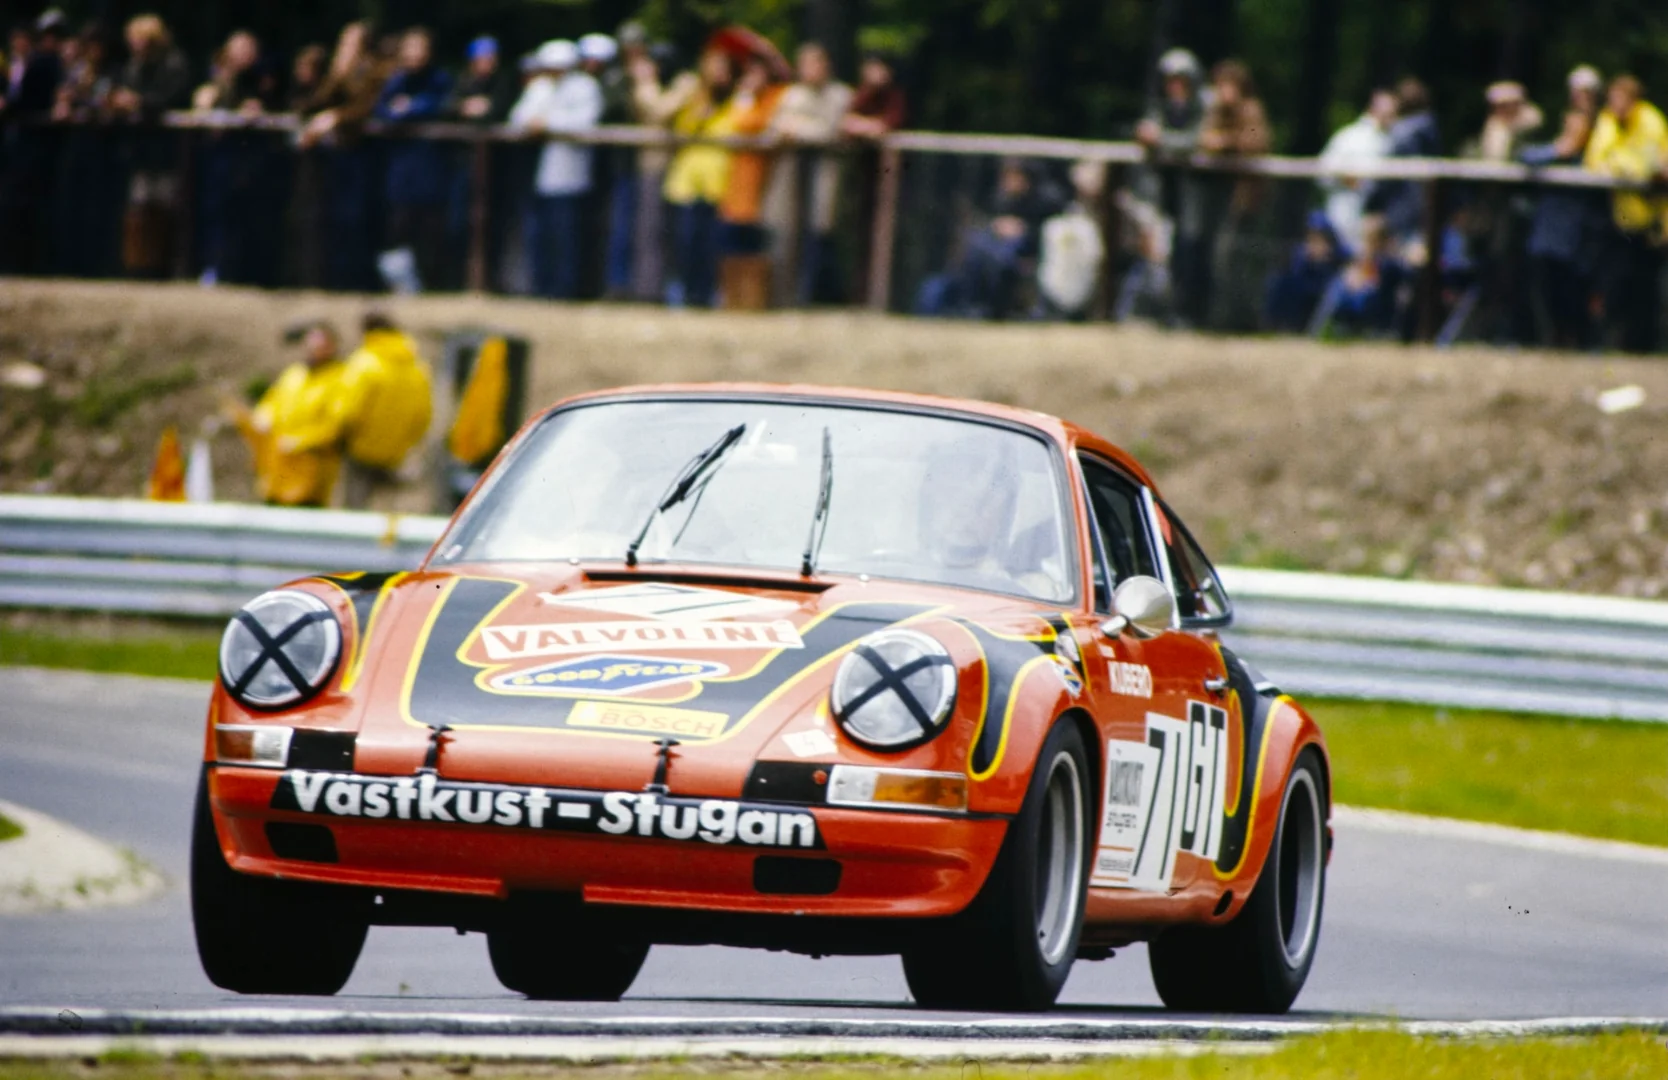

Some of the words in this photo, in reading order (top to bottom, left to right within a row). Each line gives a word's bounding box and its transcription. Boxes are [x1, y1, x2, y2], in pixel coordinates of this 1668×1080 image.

[490, 626, 798, 653] VALVOLINE
[599, 711, 717, 735] BOSCH
[1179, 702, 1225, 856] GT
